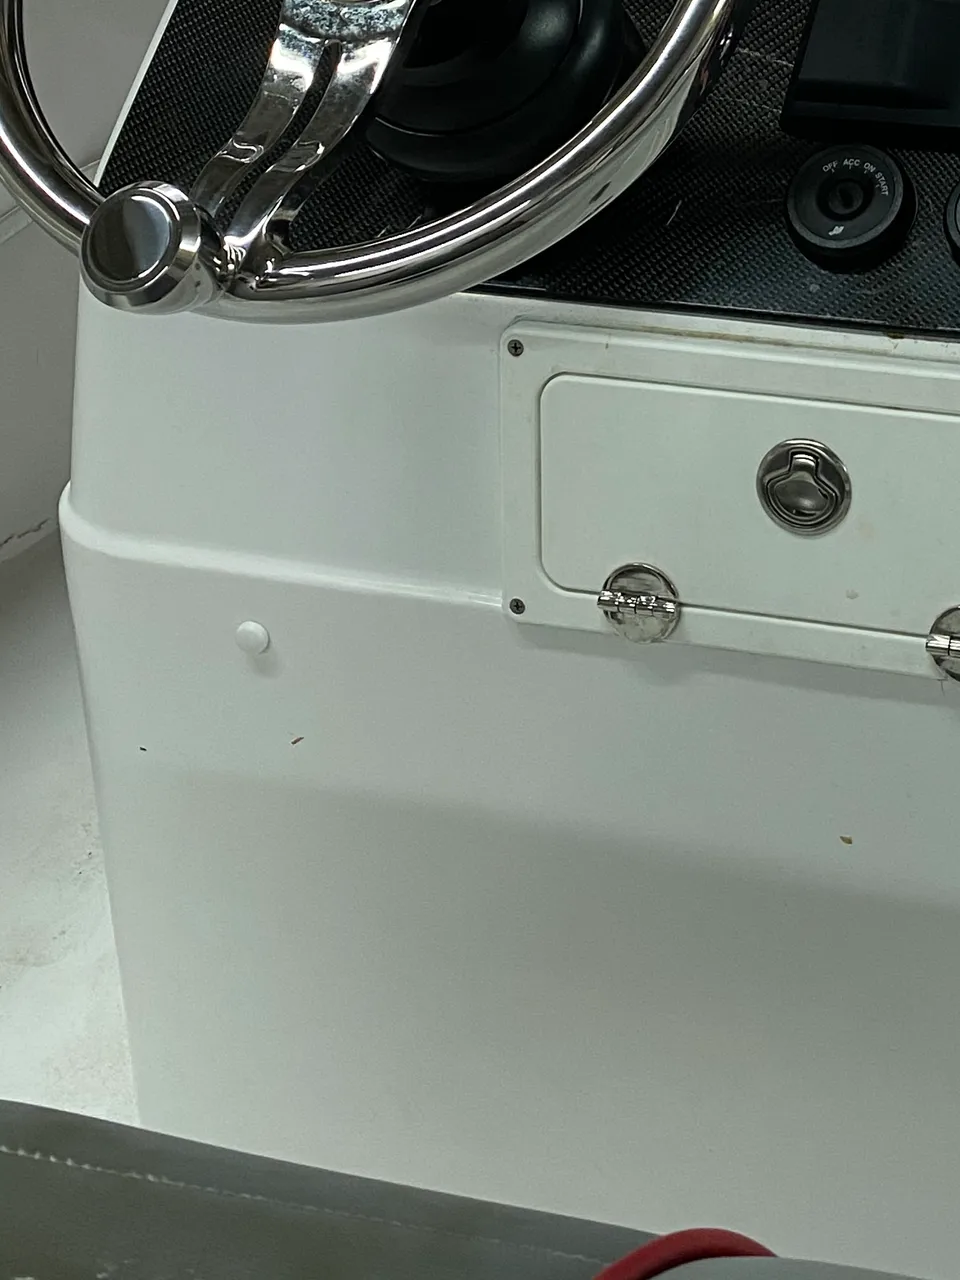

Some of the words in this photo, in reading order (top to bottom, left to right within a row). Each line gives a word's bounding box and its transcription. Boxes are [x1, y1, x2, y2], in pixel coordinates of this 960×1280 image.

[822, 160, 839, 173] OFF
[843, 158, 861, 167] ACC
[863, 162, 877, 173] ON
[875, 171, 889, 196] START
